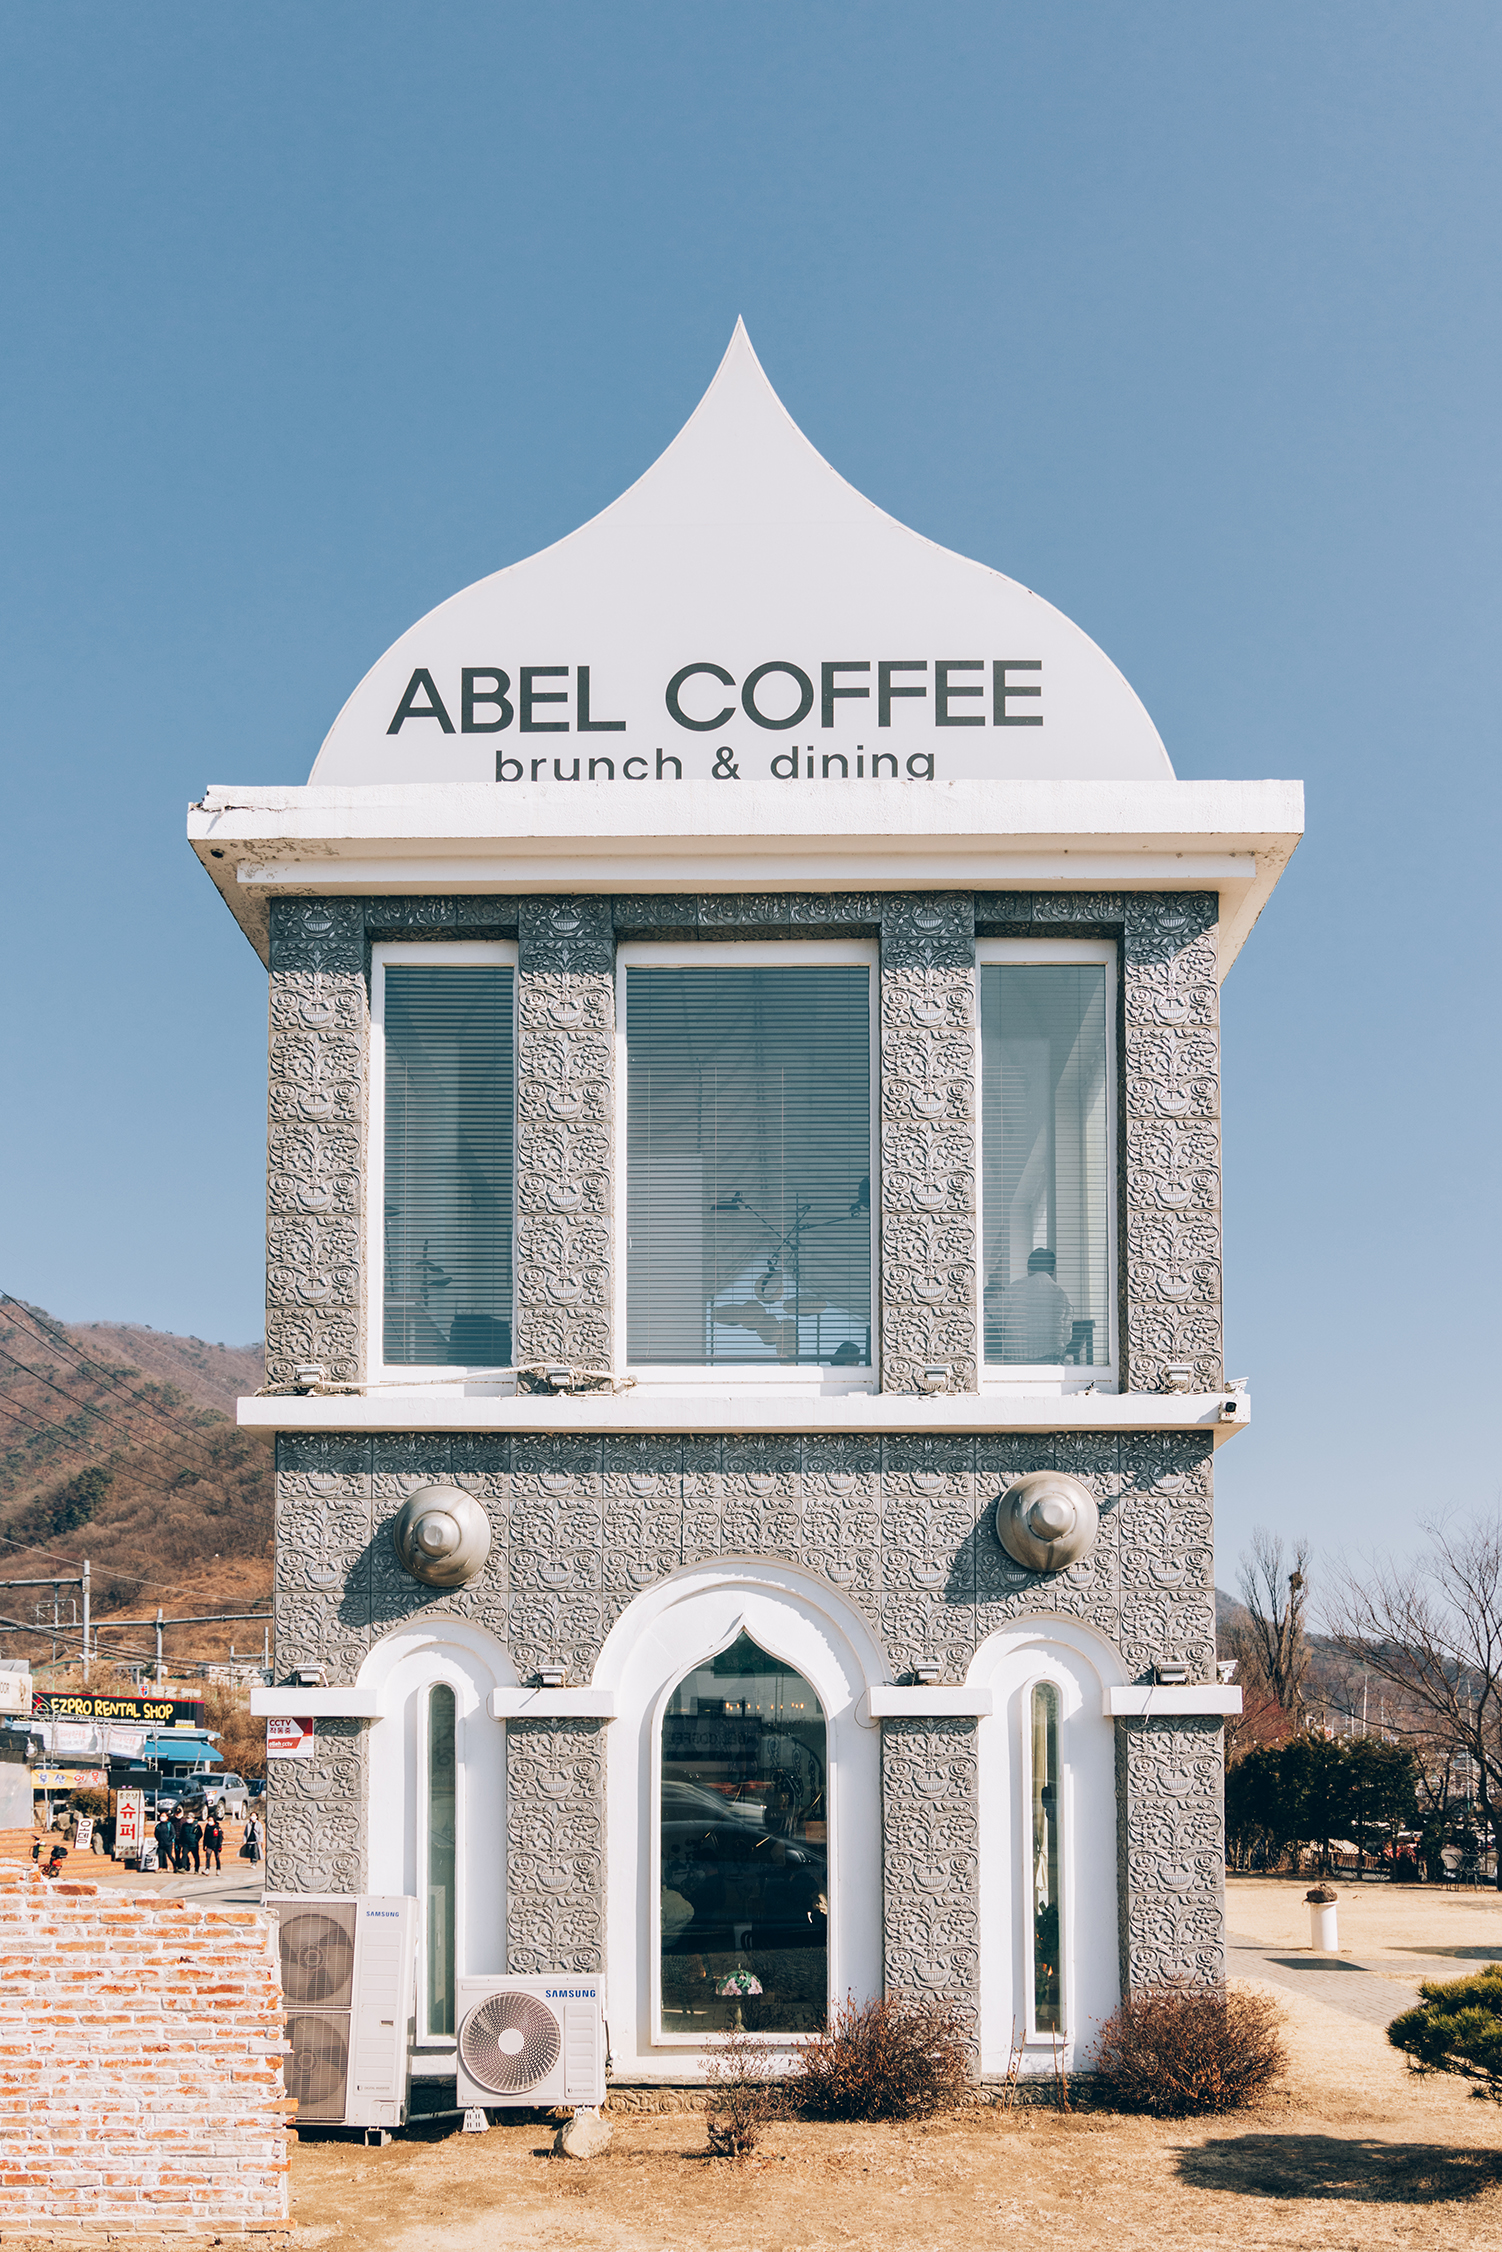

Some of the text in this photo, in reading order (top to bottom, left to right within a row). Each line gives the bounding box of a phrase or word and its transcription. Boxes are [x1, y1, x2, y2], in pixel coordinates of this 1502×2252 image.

[386, 660, 1044, 735] ABEL COFFEE
[495, 744, 936, 783] brunch & dining
[50, 1697, 174, 1720] EZPRO RENTAL SHOP
[269, 1718, 292, 1727] CCTV
[76, 1820, 92, 1845] 오뎅
[119, 1802, 136, 1840] 슈퍼
[366, 1910, 400, 1918] SAMSUNG
[545, 1989, 596, 1998] SAMSUNG
